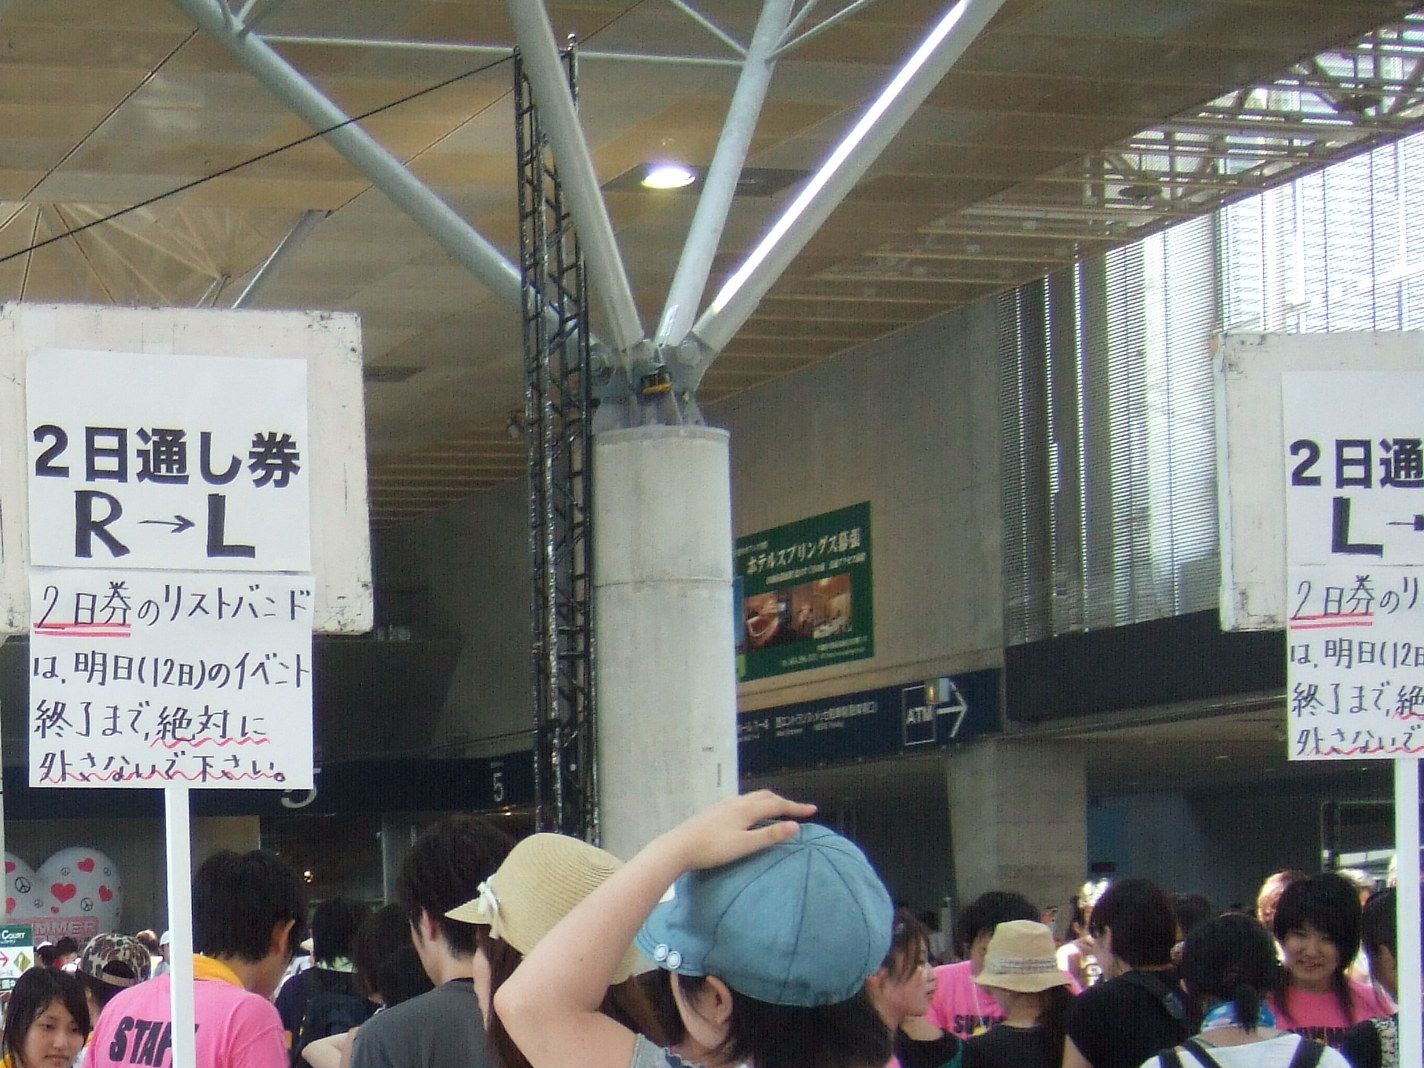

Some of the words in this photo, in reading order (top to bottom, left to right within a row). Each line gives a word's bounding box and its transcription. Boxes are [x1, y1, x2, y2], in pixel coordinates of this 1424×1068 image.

[34, 425, 301, 488] 2日通し券
[74, 490, 130, 557] R
[206, 493, 256, 559] L
[1331, 496, 1384, 557] L
